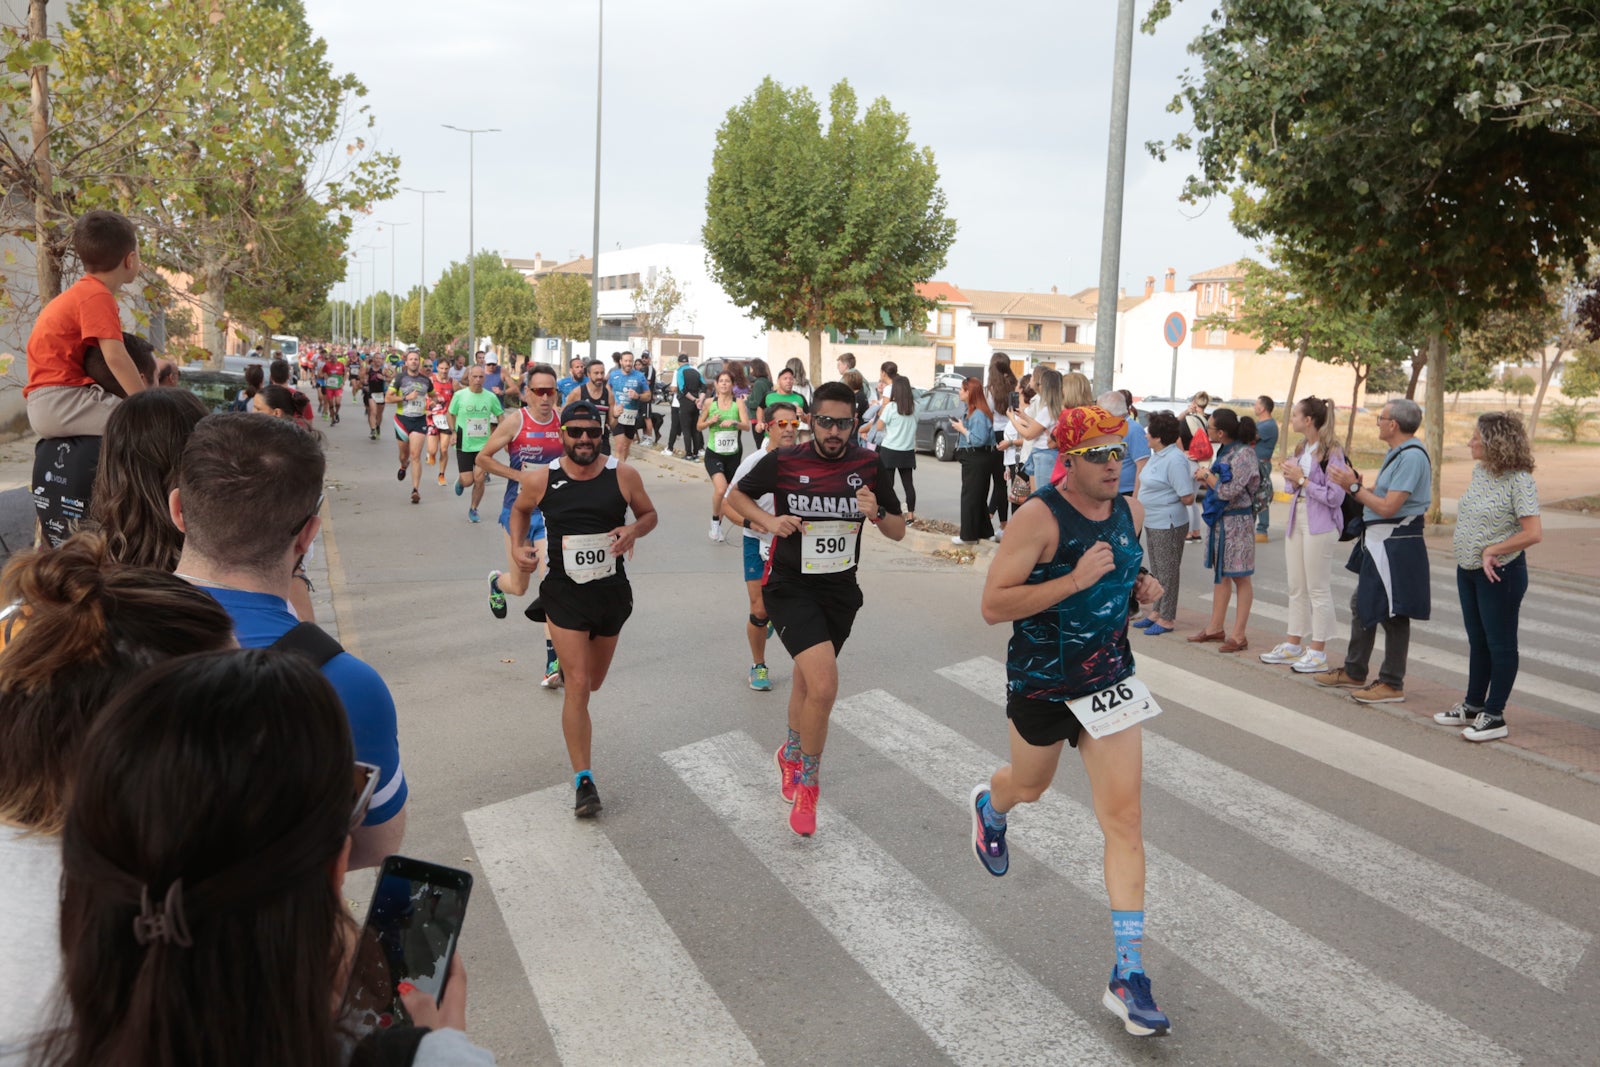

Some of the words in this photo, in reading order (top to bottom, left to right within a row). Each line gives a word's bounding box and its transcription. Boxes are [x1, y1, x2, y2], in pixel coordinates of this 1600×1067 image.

[717, 439, 735, 447] 3077
[787, 493, 860, 513] GRANAD
[815, 536, 846, 554] 590
[575, 549, 606, 566] 690
[1091, 683, 1133, 713] 426
